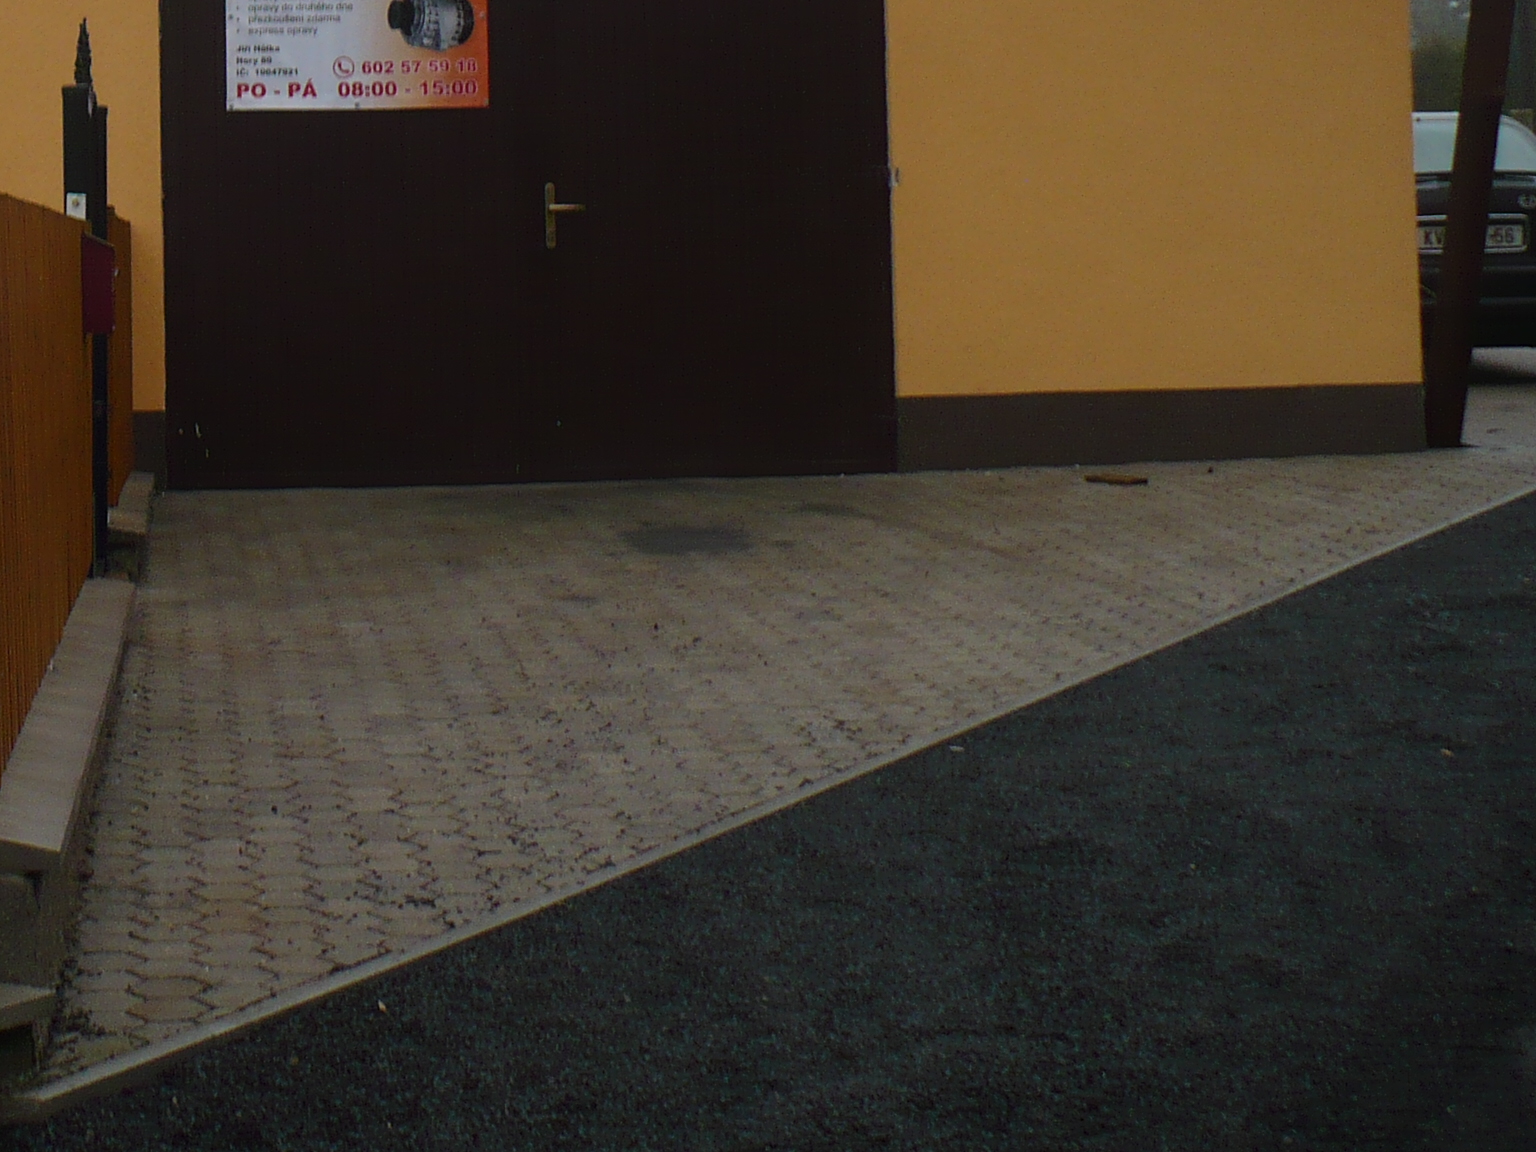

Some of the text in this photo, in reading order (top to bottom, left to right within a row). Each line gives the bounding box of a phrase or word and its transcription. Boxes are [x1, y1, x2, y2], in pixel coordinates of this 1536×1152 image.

[362, 60, 394, 74] 602
[401, 60, 421, 73] 57
[458, 58, 476, 72] 18
[237, 83, 266, 98] PO
[288, 78, 317, 98] PÁ
[338, 81, 397, 97] 08:00
[420, 79, 477, 96] 15:00
